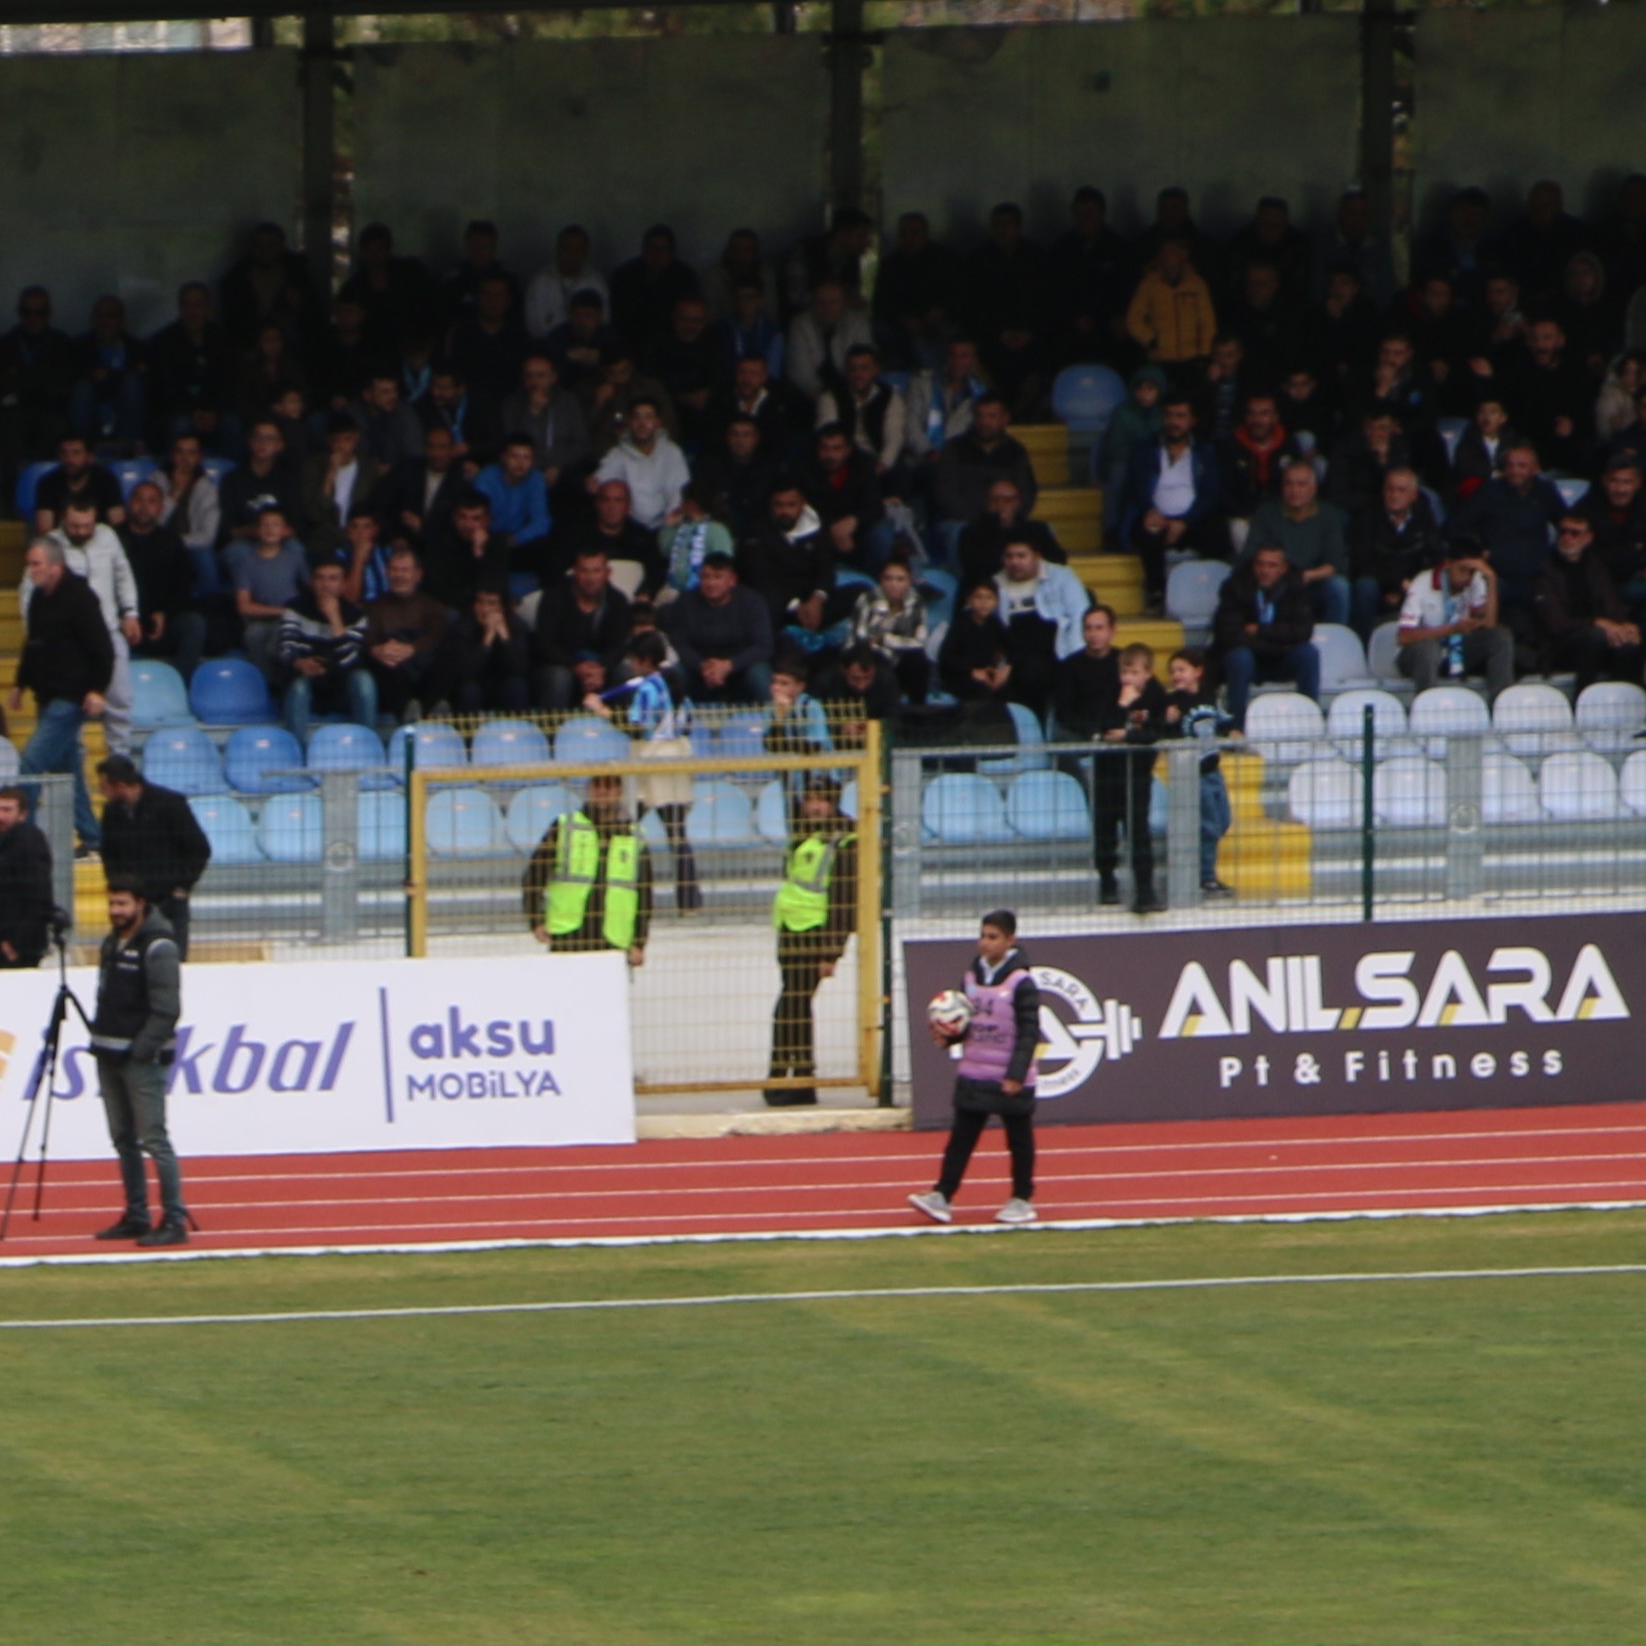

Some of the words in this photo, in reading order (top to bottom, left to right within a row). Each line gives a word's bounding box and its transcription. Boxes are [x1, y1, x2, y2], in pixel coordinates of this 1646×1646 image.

[410, 1006, 554, 1059] aksu
[22, 1021, 355, 1101] iskbal
[1220, 1055, 1272, 1087] Pt
[1294, 1053, 1321, 1083] &
[1345, 1048, 1564, 1082] Fitness
